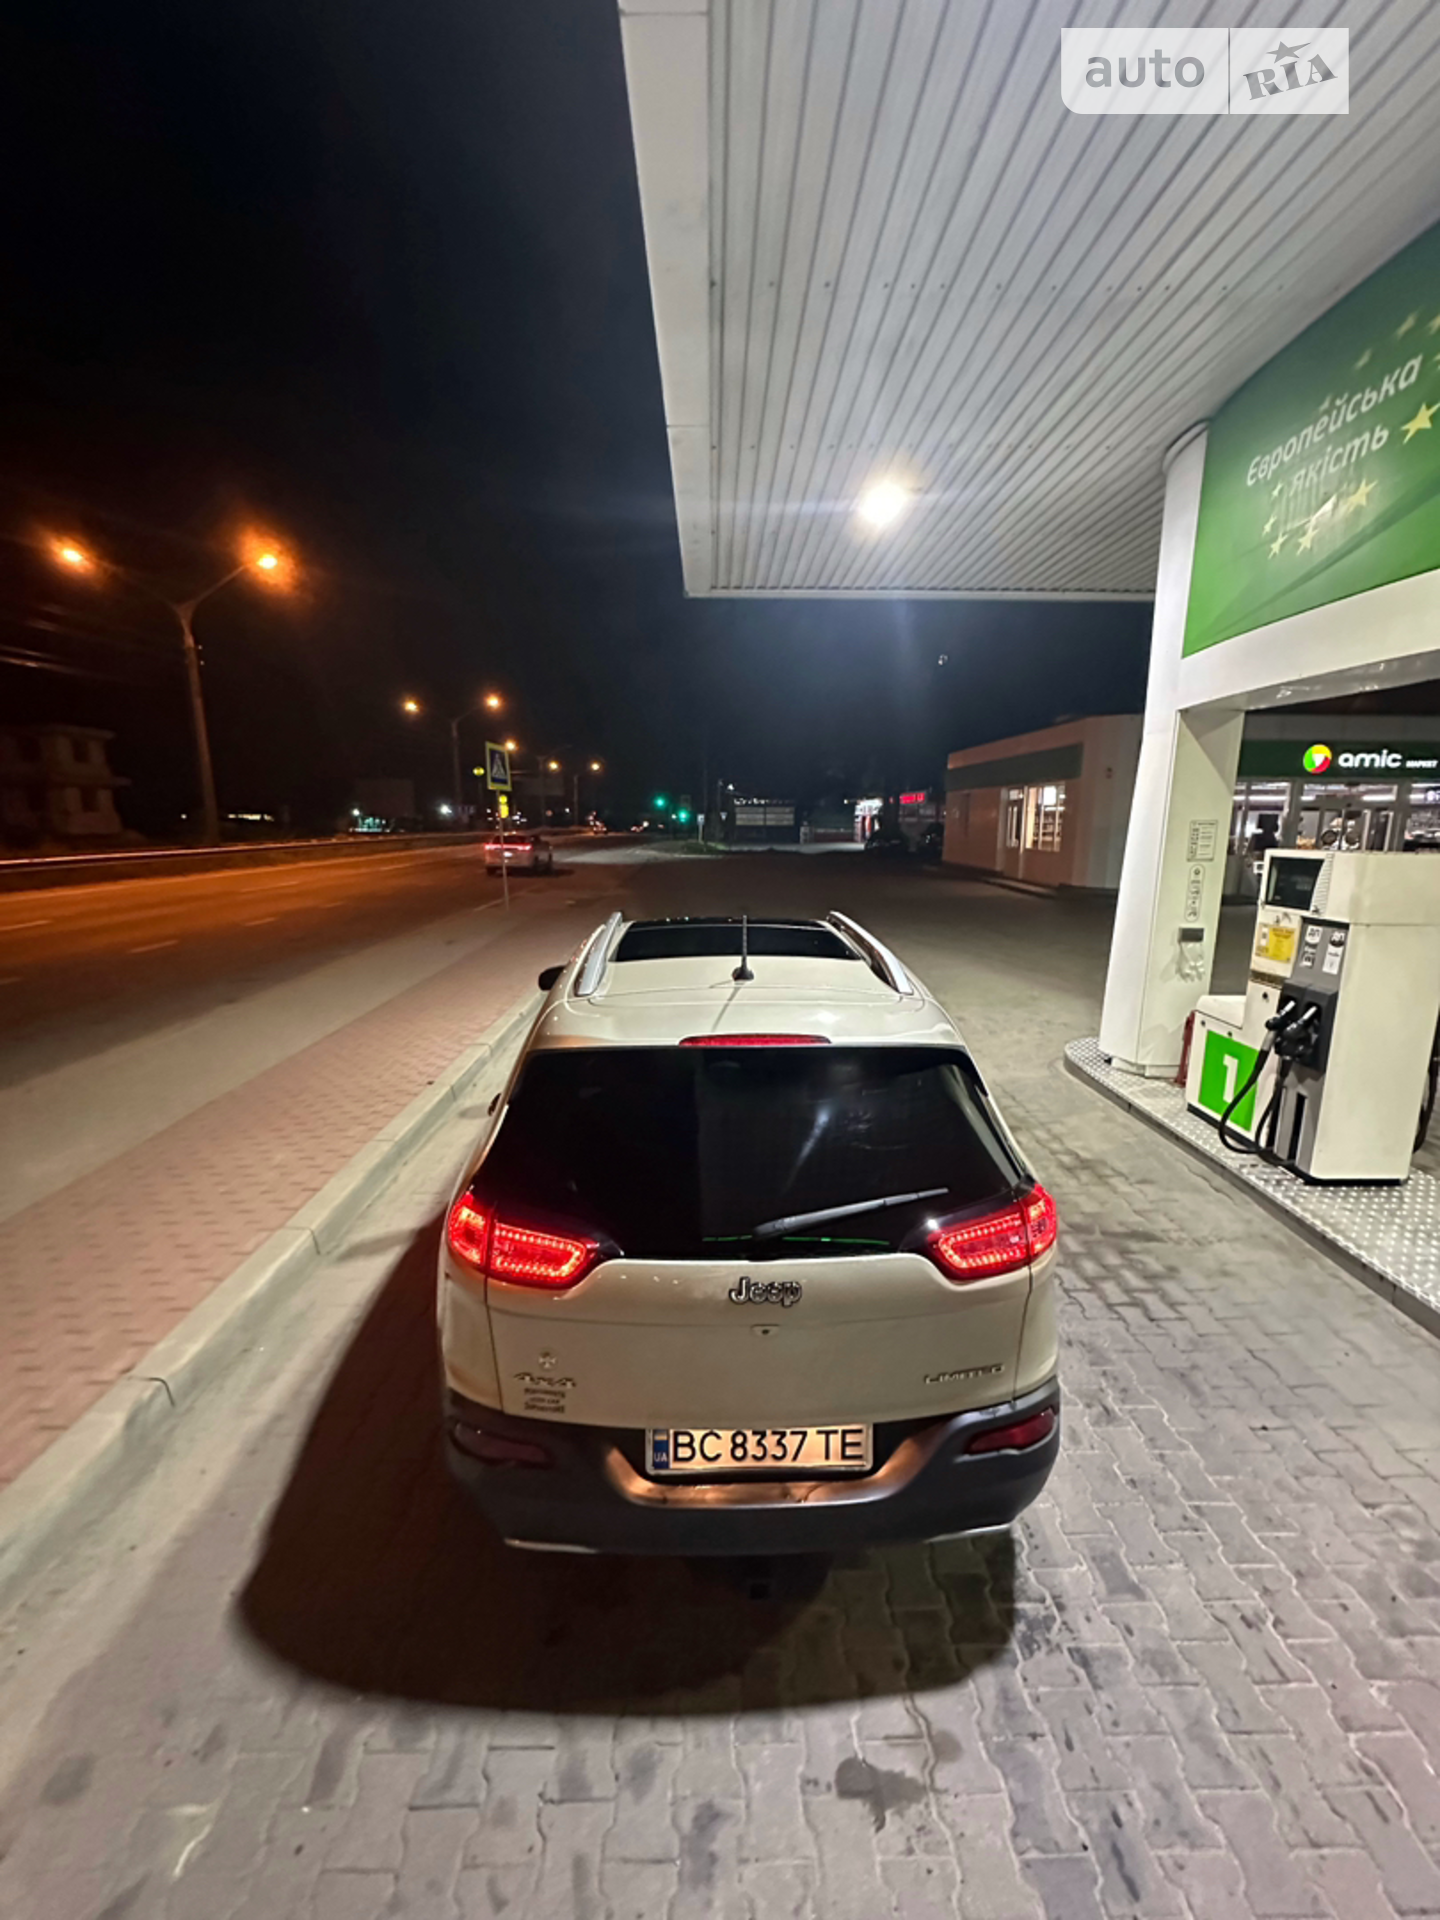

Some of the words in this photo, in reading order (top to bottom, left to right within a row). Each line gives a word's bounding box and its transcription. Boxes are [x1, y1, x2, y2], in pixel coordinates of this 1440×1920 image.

[1246, 353, 1422, 486] Європейська
[1338, 749, 1402, 768] amic
[1222, 1053, 1239, 1103] 1
[728, 1276, 802, 1308] Jeep
[654, 1451, 668, 1463] UA
[673, 1430, 722, 1462] BC
[730, 1430, 808, 1462] 8337
[816, 1428, 863, 1460] TE
